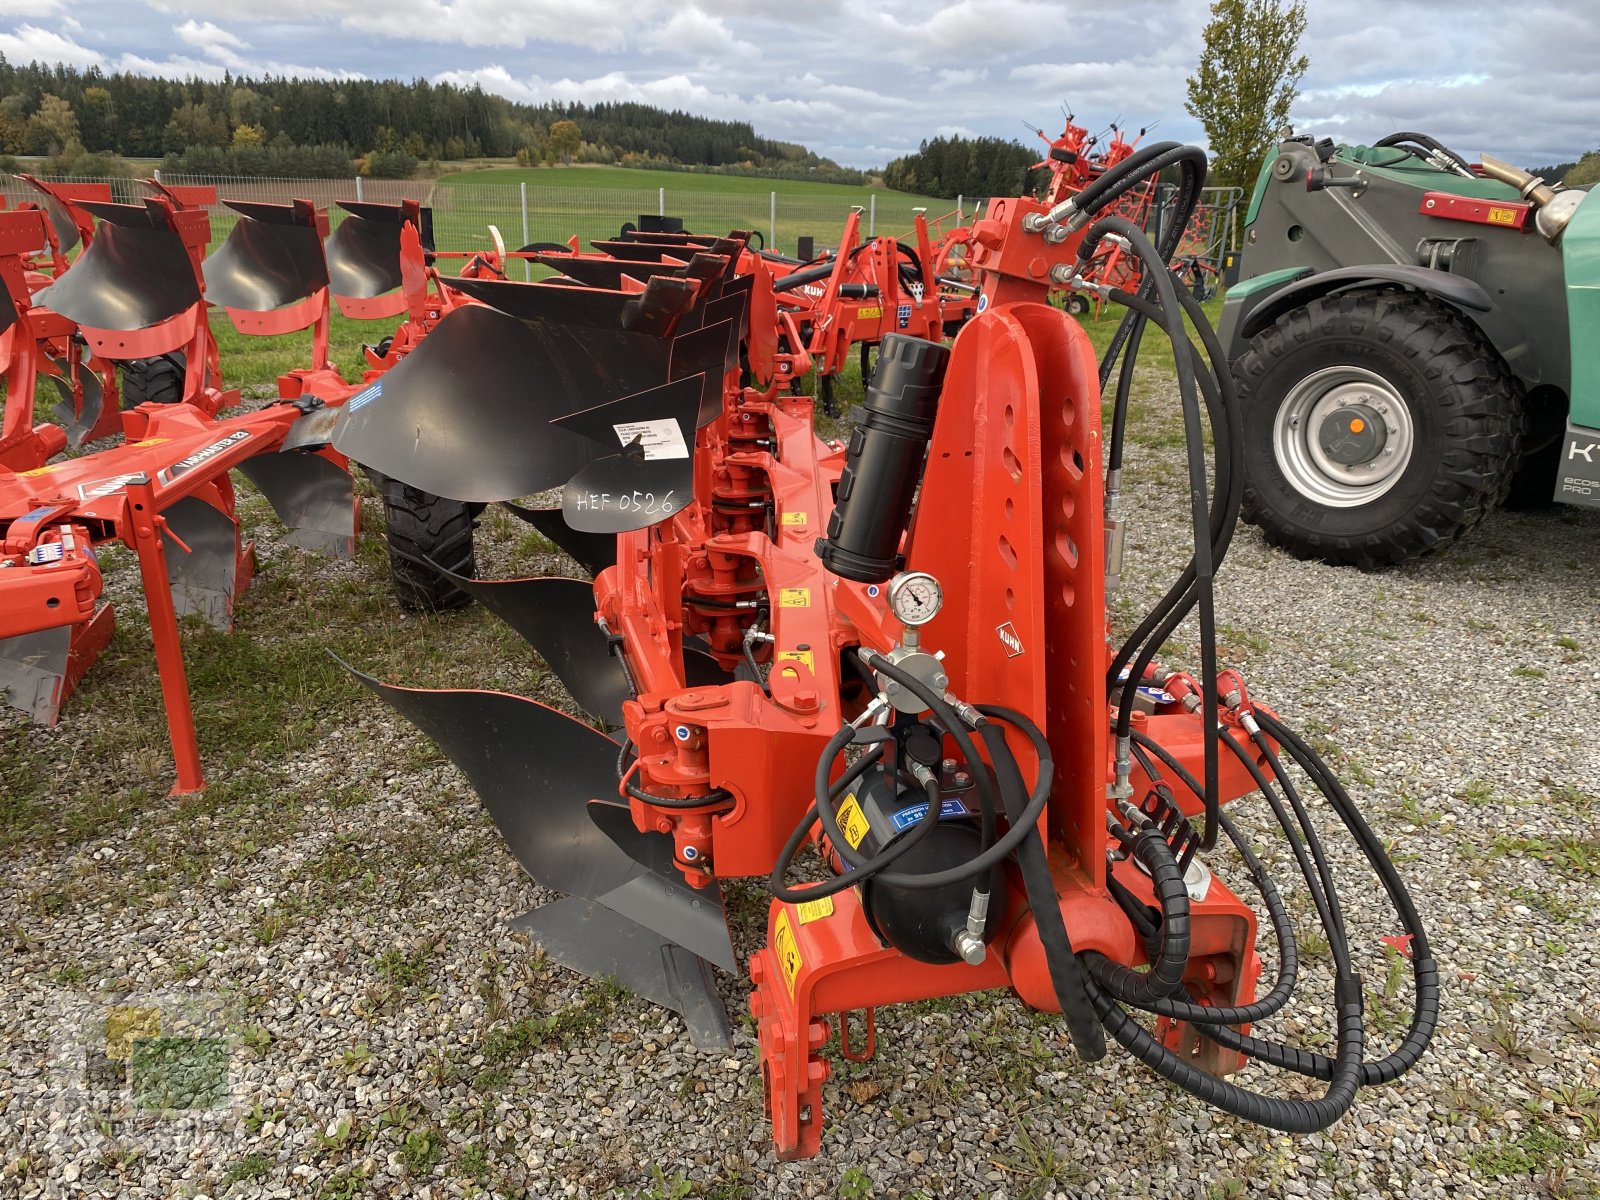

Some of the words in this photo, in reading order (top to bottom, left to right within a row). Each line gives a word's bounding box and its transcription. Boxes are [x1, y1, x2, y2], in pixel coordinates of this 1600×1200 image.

[577, 491, 611, 511] HEF
[619, 490, 674, 514] 0526
[1563, 485, 1592, 495] PRO
[1000, 628, 1019, 652] KUHN
